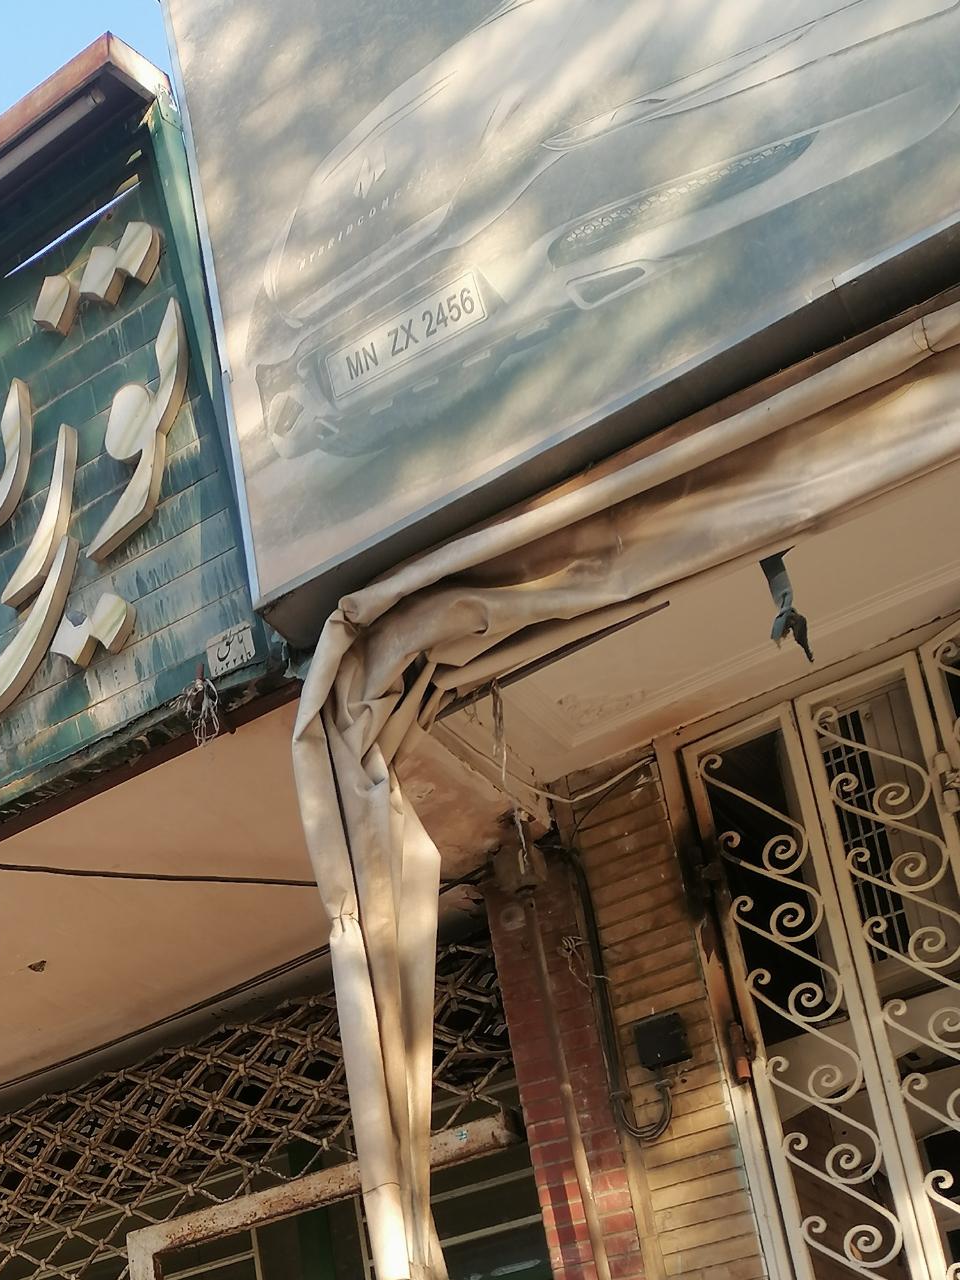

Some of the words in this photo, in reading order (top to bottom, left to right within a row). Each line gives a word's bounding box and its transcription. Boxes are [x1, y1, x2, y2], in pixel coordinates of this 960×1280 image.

[345, 342, 379, 381] MN
[387, 319, 419, 357] ZX
[421, 287, 475, 337] 2456
